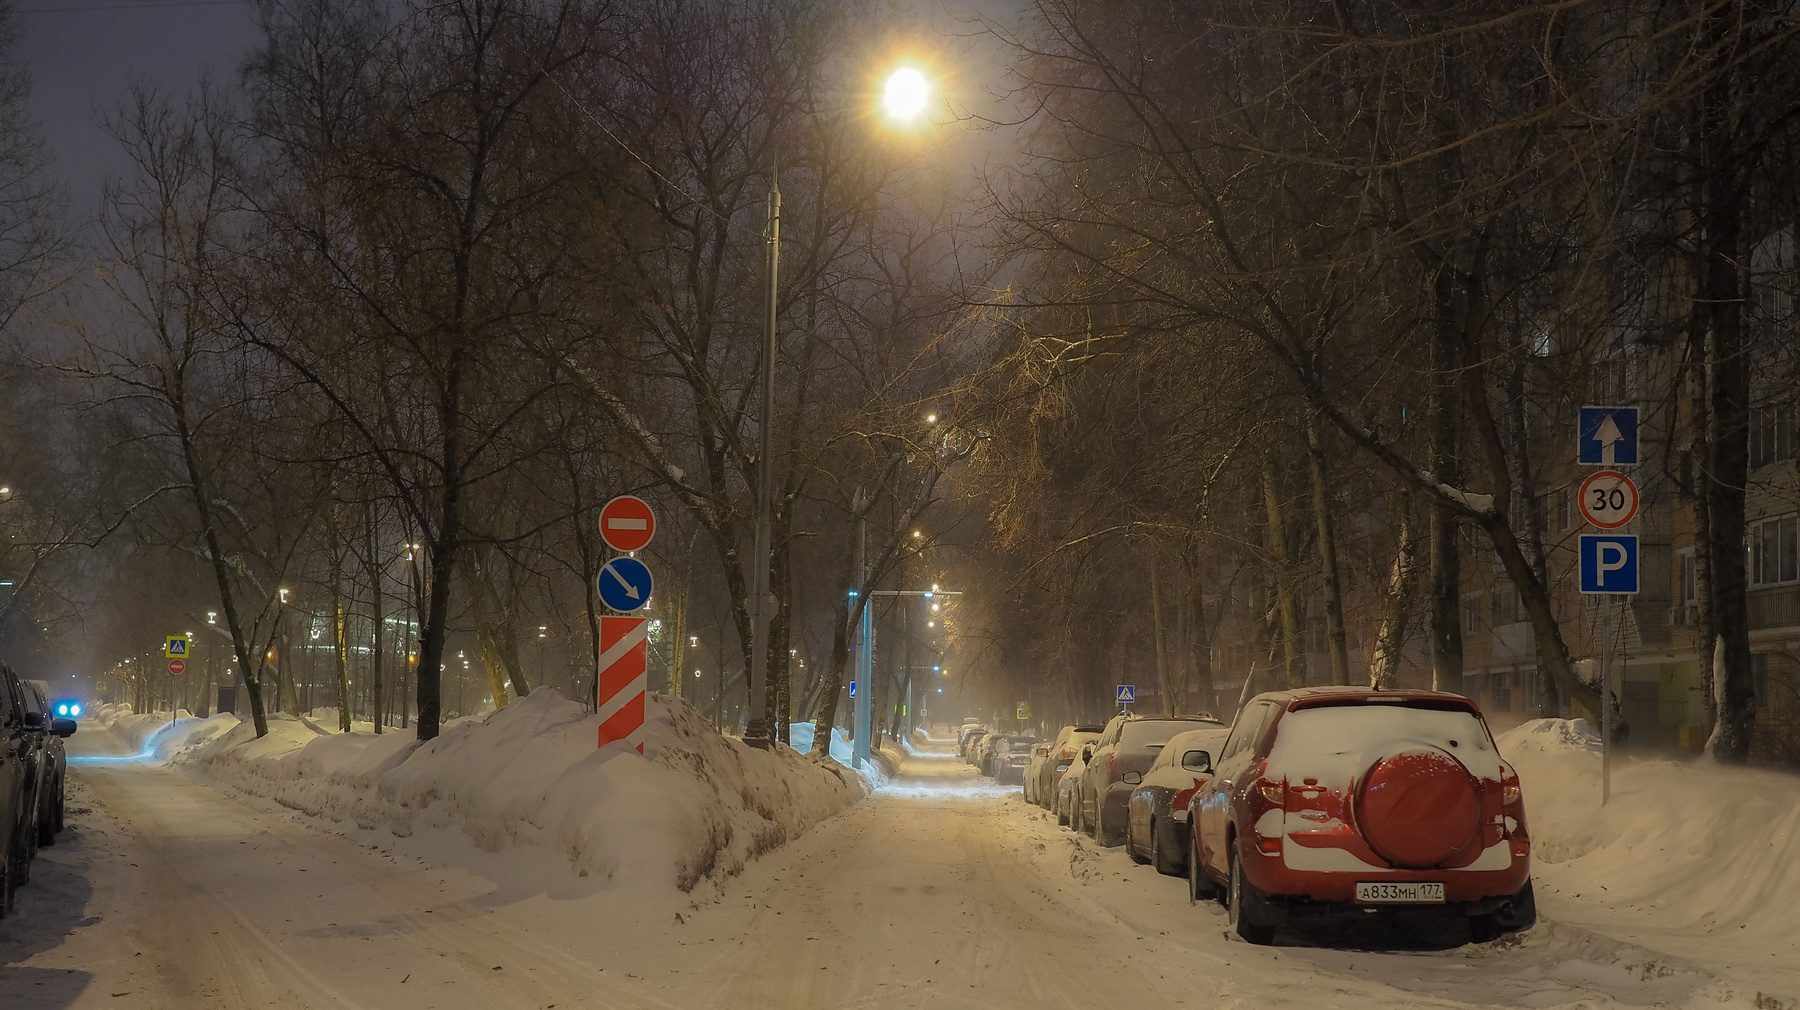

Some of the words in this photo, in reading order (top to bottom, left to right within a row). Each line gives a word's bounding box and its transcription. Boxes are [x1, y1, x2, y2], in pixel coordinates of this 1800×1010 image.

[1592, 488, 1625, 511] 30
[1596, 541, 1628, 587] P
[1419, 884, 1440, 895] 177
